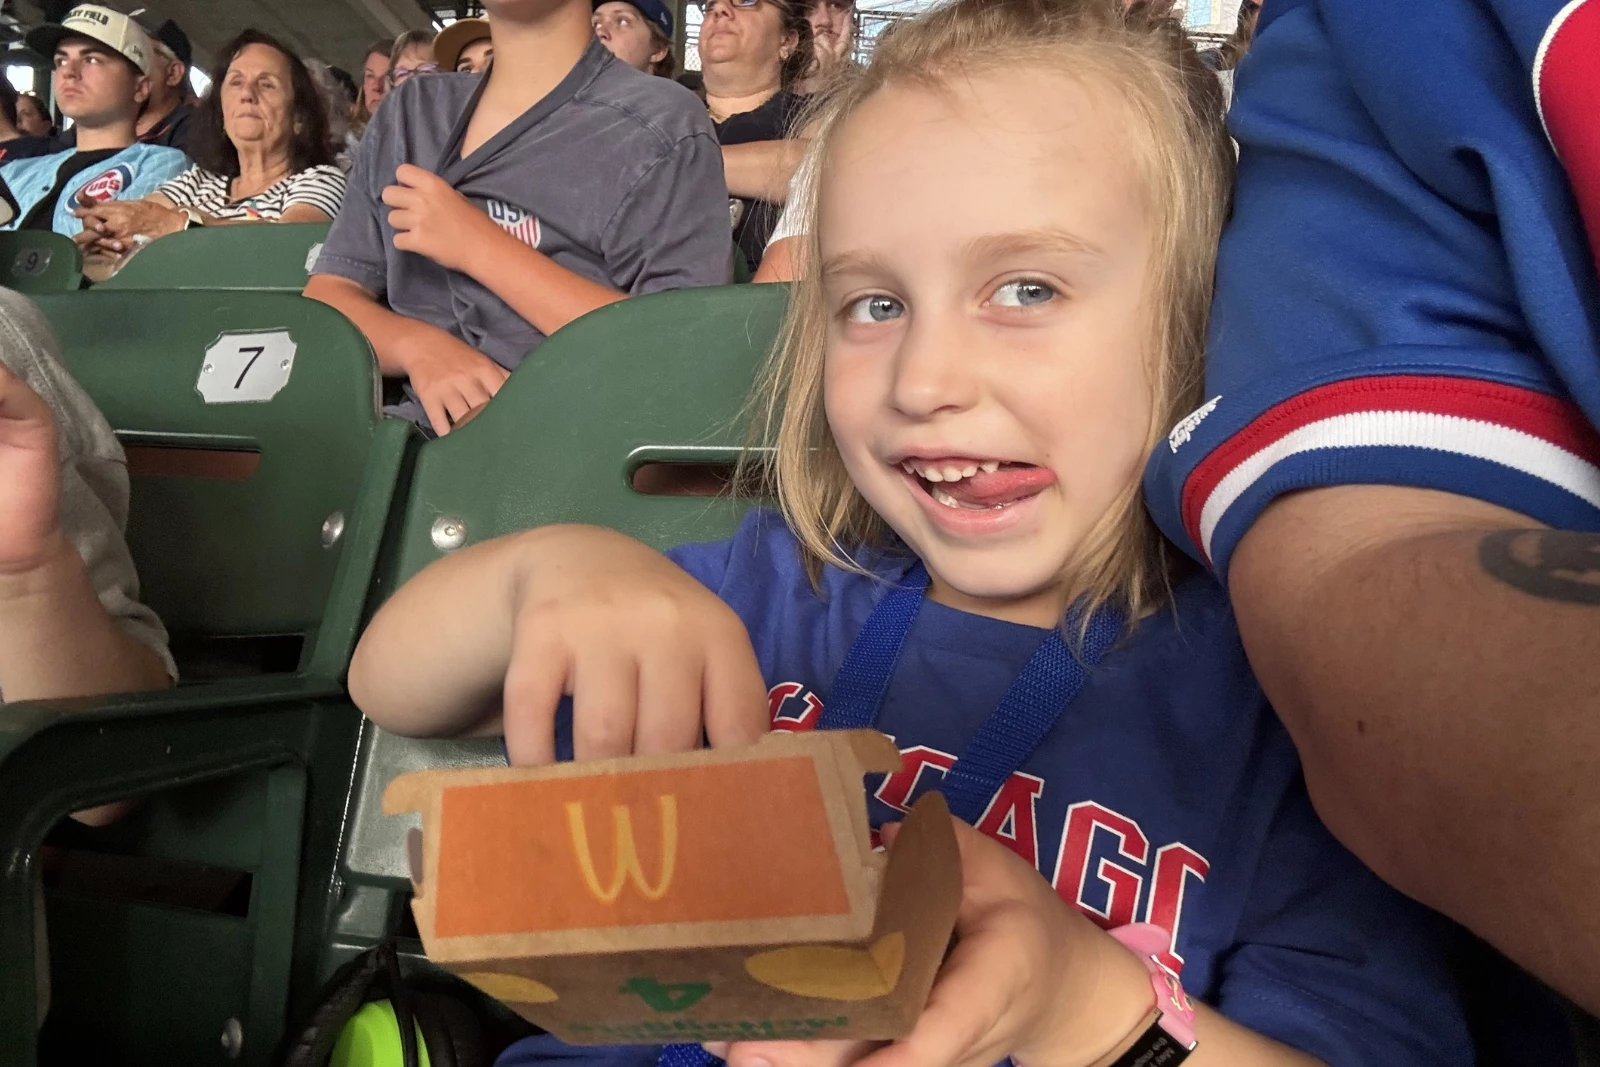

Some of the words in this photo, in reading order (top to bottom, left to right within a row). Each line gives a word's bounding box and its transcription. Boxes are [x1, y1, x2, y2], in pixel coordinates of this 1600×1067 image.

[491, 200, 528, 224] US
[26, 251, 39, 272] 9
[233, 346, 265, 389] 7
[619, 977, 713, 1013] 4
